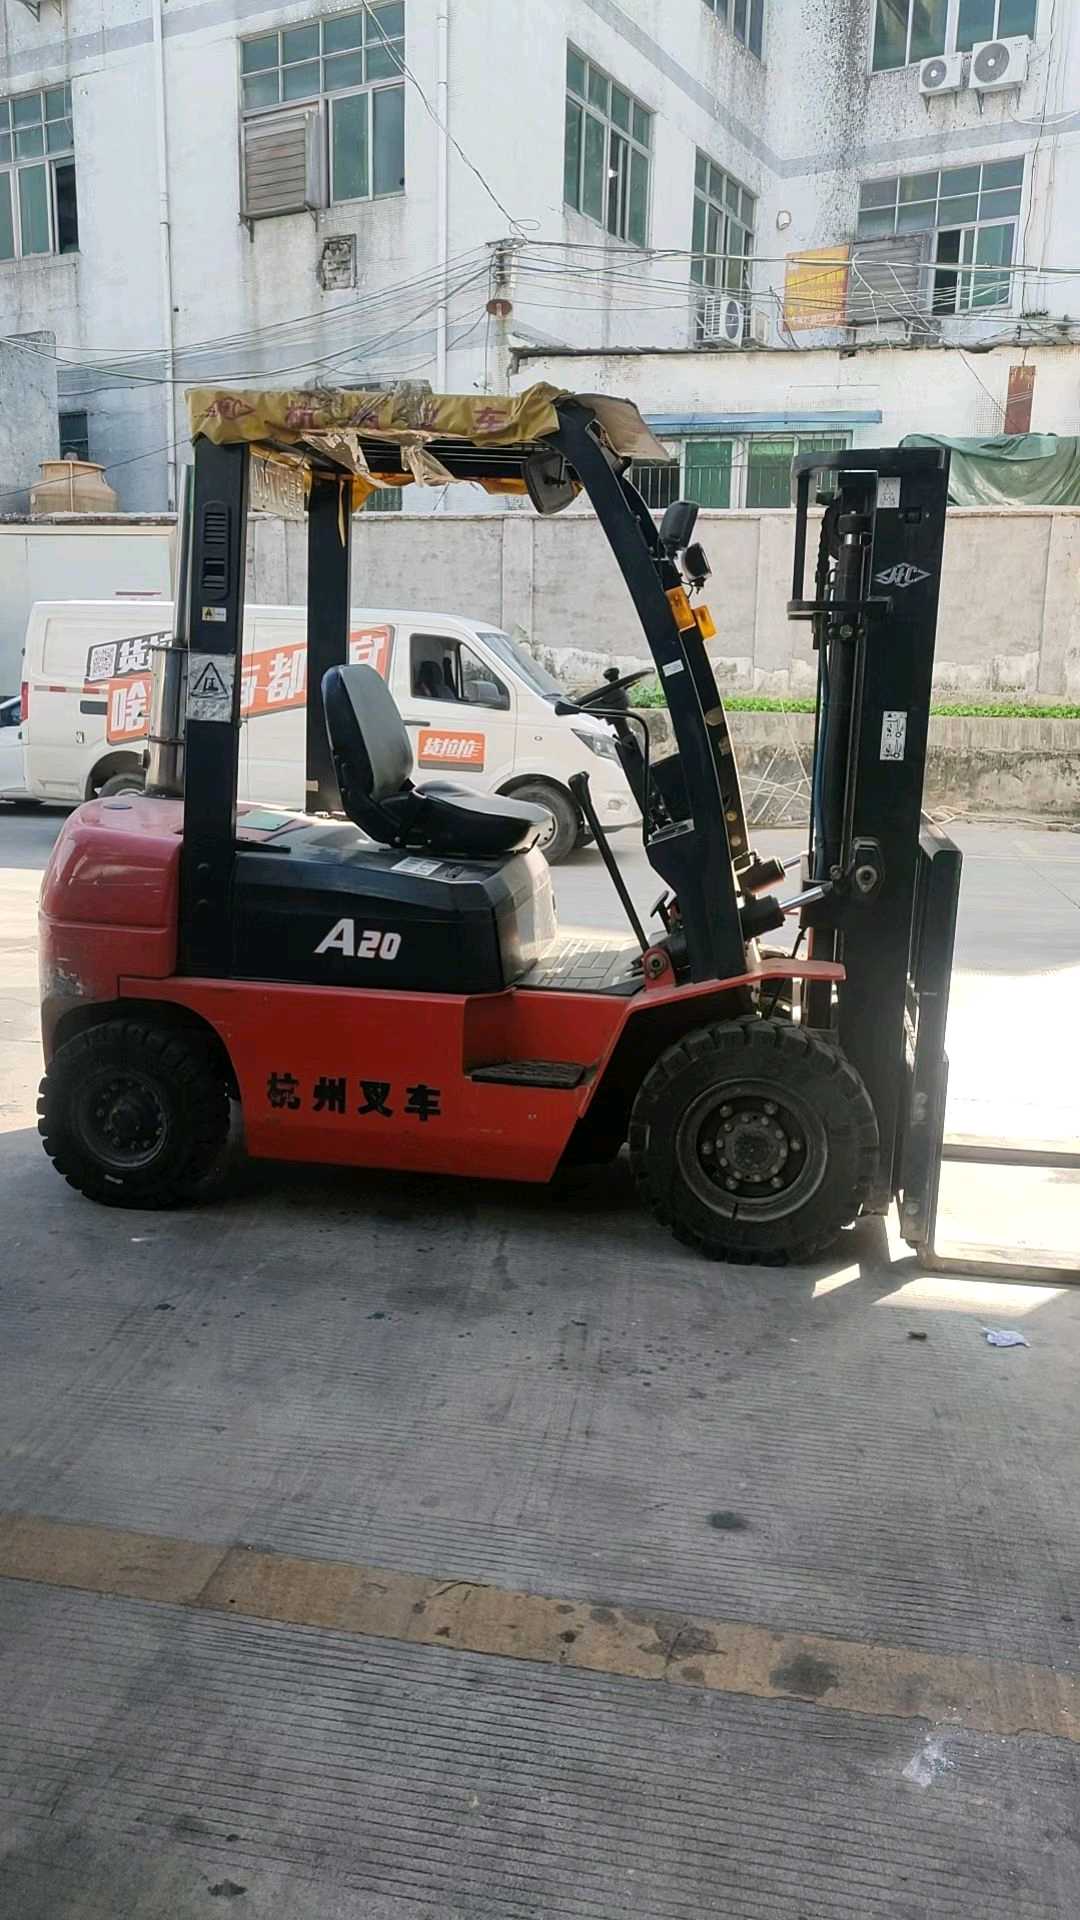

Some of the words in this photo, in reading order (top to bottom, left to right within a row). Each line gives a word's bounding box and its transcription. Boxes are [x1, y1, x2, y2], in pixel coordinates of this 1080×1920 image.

[314, 918, 402, 960] A20
[267, 1072, 442, 1121] 杭州叉车
